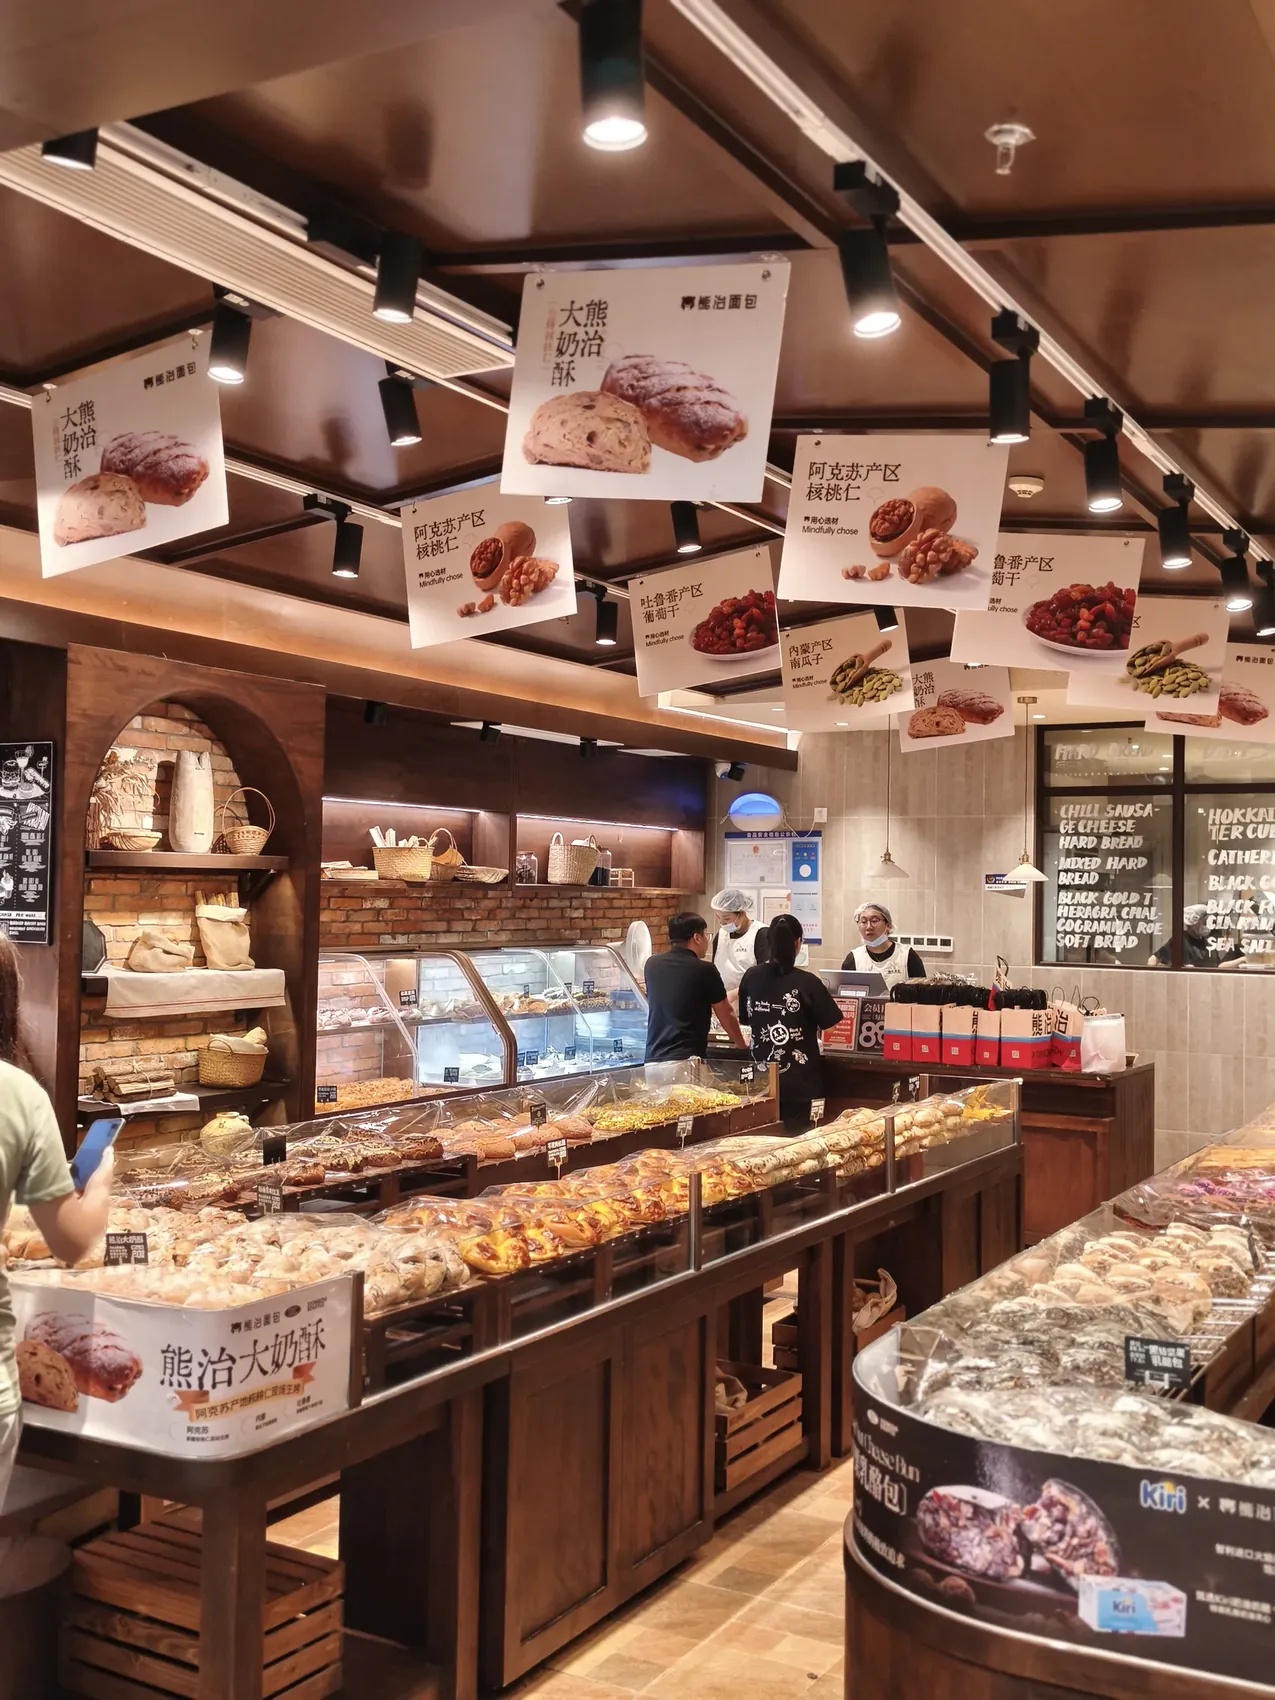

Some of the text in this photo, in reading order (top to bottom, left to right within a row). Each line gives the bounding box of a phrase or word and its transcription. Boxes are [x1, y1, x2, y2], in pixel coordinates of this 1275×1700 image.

[808, 461, 901, 482] 阿克苏产区
[806, 483, 860, 501] 核桃仁
[414, 509, 486, 542] 阿克苏产区
[810, 516, 839, 525] 用心选材
[802, 525, 859, 535] Mindfully chose
[416, 536, 459, 560] 核桃仁
[993, 554, 1055, 572] 鲁番产区
[419, 573, 463, 588] Mindfully chose
[424, 568, 446, 579] 用心选材
[992, 571, 1020, 587] 萄干
[640, 582, 703, 609] 吐鲁番产区
[642, 603, 679, 623] 葡萄干
[645, 634, 684, 647] Mindfully chose
[789, 638, 833, 657] 内蒙产区
[790, 653, 823, 670] 南瓜子
[792, 680, 813, 689] Mindfully
[1077, 820, 1137, 834] CHEESE
[1059, 836, 1143, 849] HARD BREAD
[1058, 857, 1148, 871] MIXED HARD
[1058, 872, 1099, 885] BREAD
[1208, 875, 1275, 891] BLACK G
[1058, 892, 1099, 905] BLACK
[1103, 892, 1140, 905] GOLD
[1057, 905, 1118, 919] HERAGRA
[1206, 899, 1255, 914] BLACK
[1136, 922, 1163, 935] ROE
[1056, 934, 1139, 949] SOFT BREAD
[1206, 937, 1235, 952] SEA
[160, 1318, 326, 1390] 熊治大奶酥
[186, 1426, 209, 1434] 阿克苏
[1140, 1479, 1187, 1514] Kiri
[1239, 1501, 1275, 1521] 熊治
[1112, 1599, 1136, 1614] Kiri
